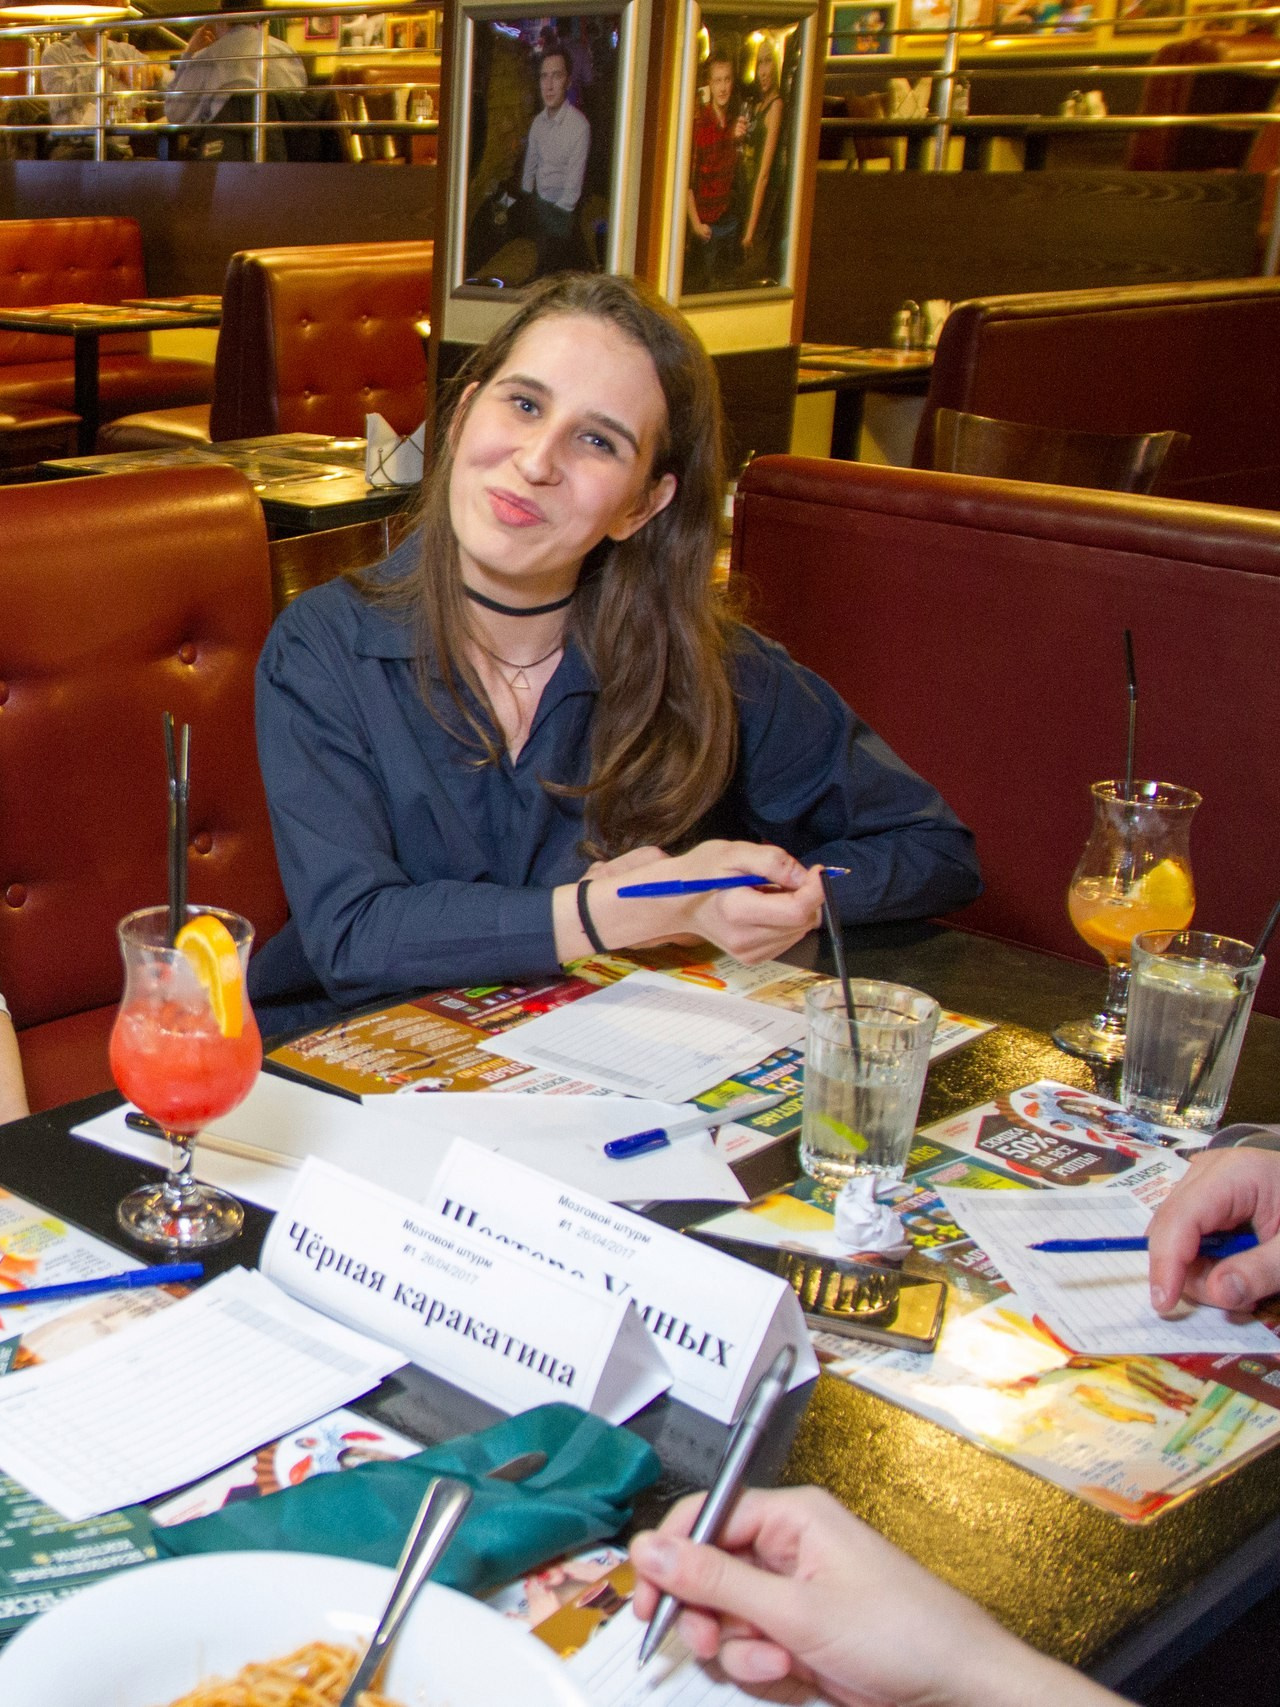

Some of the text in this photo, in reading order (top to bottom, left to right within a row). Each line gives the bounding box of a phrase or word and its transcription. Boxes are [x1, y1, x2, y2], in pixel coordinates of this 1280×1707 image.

[979, 1127, 1030, 1149] СКИДКА
[996, 1132, 1059, 1159] 50%
[1031, 1144, 1078, 1168] НА ВСЕ
[558, 1194, 653, 1245] Мозговой штурм
[558, 1219, 573, 1232] #1
[576, 1226, 637, 1260] 26/04/2017
[403, 1218, 455, 1251] Мозговой
[456, 1246, 493, 1270] штурм
[403, 1244, 417, 1258] #1
[420, 1250, 480, 1285] 26/04/2017
[289, 1219, 387, 1293] Чёрная
[392, 1281, 577, 1389] каракатица
